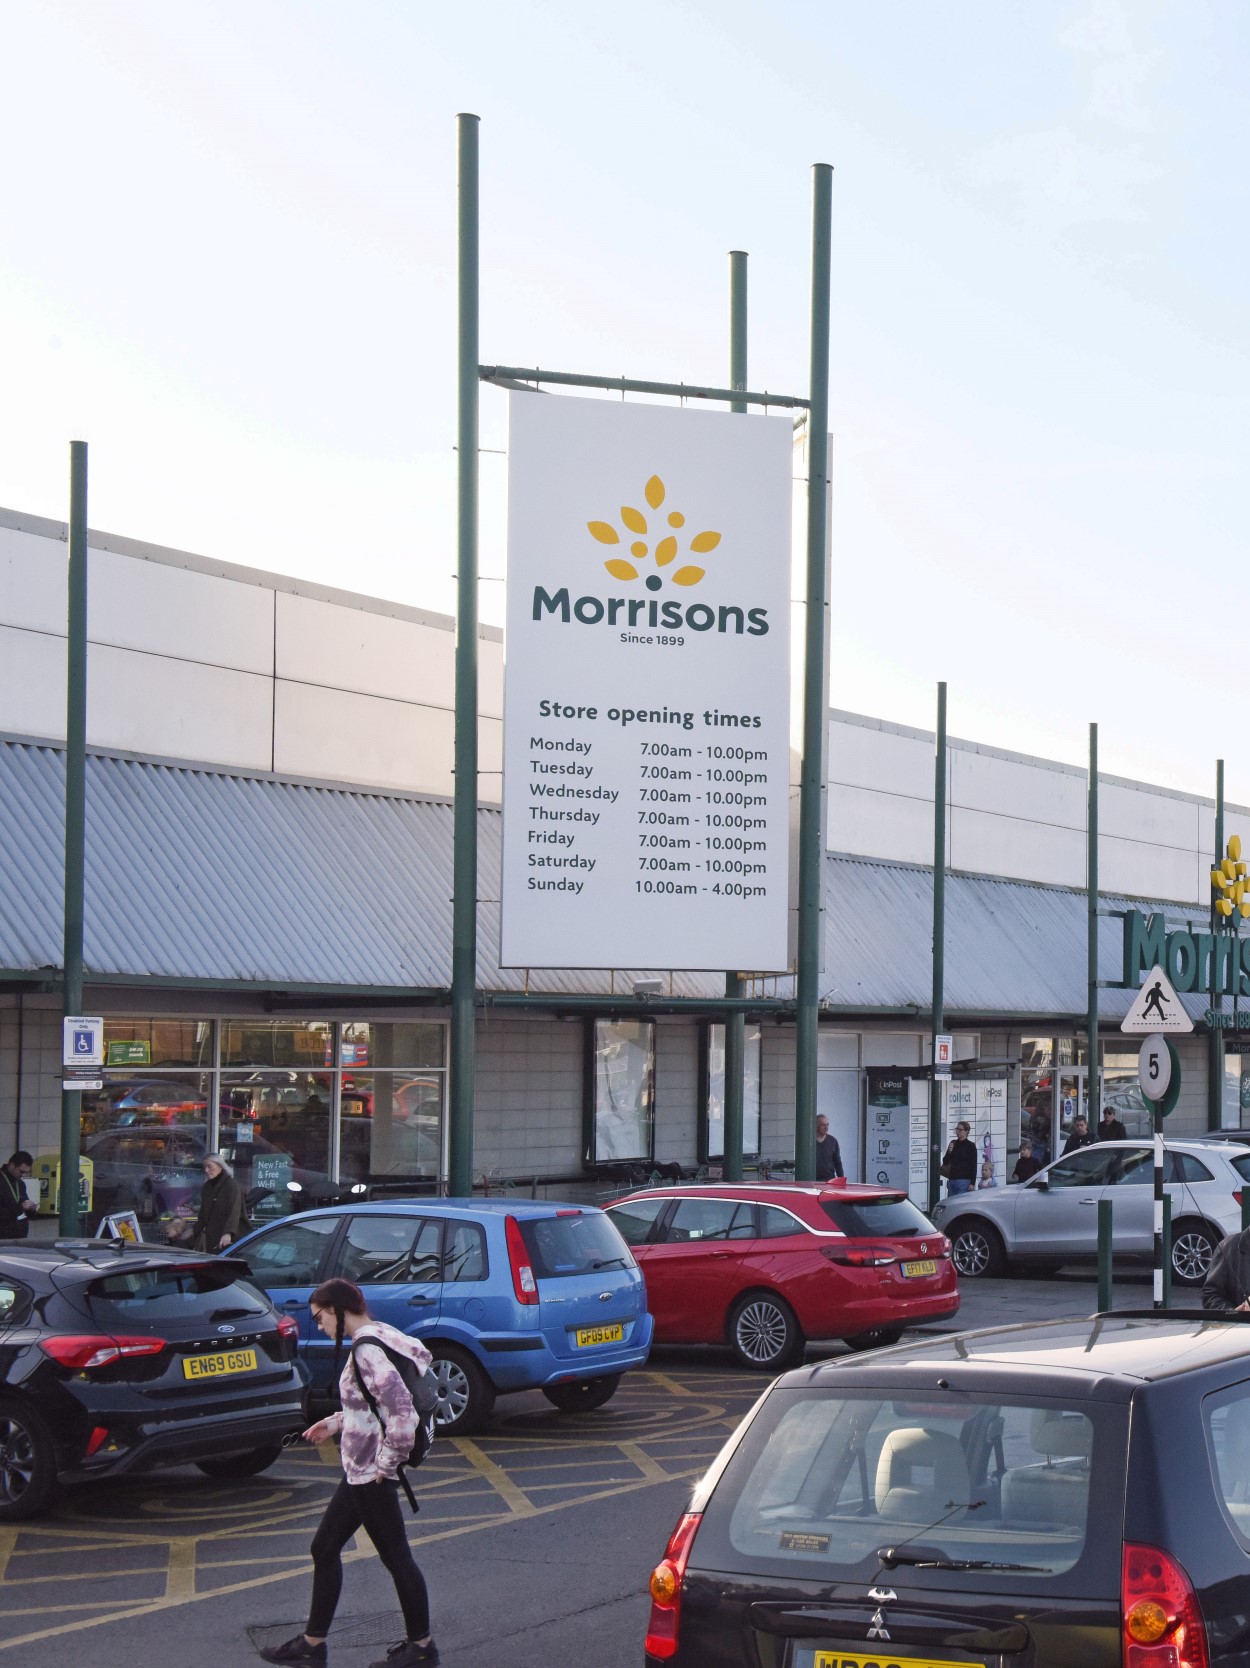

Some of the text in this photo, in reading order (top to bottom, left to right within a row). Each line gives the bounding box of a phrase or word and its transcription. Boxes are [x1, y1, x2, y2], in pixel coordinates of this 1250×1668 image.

[532, 585, 770, 636] Morrisons
[620, 632, 685, 647] Since 1899
[539, 700, 762, 730] Store opening times
[530, 737, 592, 755] Monday
[640, 742, 692, 757] 7.00am
[706, 746, 768, 763] 10.00pm
[530, 760, 593, 778] Tuesday
[640, 766, 692, 780] 7.00am
[706, 769, 768, 786] 10.00pm
[530, 783, 619, 803] Wednesday
[639, 789, 691, 803] 7.00am
[705, 792, 767, 809] 10.00pm
[528, 806, 600, 825] Thursday
[638, 812, 690, 826] 7.00am
[705, 815, 767, 832] 10.00pm
[528, 830, 575, 848] Friday
[638, 834, 691, 849] 7.00am
[705, 837, 767, 854] 10.00pm
[528, 854, 597, 872] Saturday
[638, 857, 691, 872] 7.00am
[705, 860, 767, 877] 10.00pm
[527, 877, 584, 895] Sunday
[635, 880, 697, 895] 10.00am
[712, 883, 767, 900] 4.00pm
[1205, 1008, 1232, 1029] Since
[1149, 1053, 1159, 1080] 5
[907, 1263, 920, 1274] EF17
[194, 1335, 261, 1347] FOCUS
[581, 1327, 620, 1343] GF09 CVP
[190, 1352, 251, 1375] EN69 GSU
